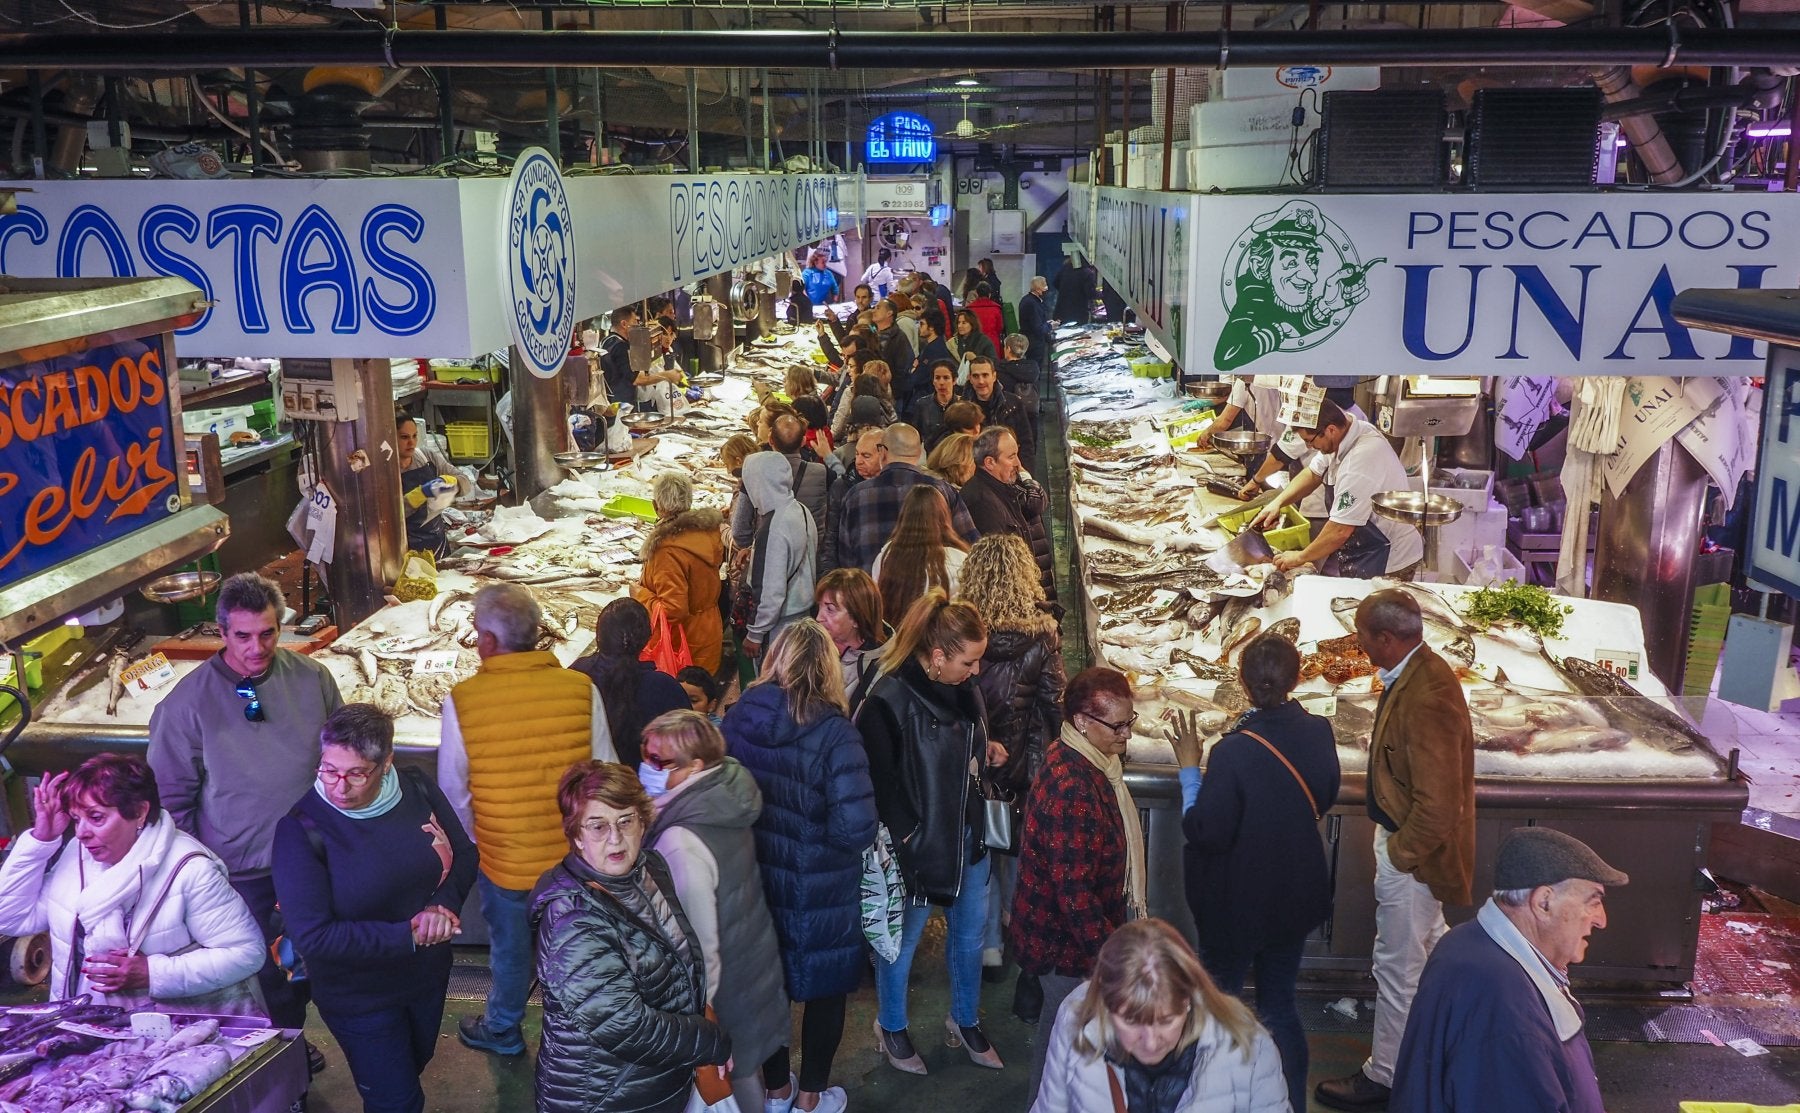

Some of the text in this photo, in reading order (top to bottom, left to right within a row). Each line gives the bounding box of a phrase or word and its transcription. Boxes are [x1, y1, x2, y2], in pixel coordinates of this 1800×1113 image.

[512, 164, 570, 249] CASA FUNDADA POR
[670, 178, 840, 282] PESCADOS COSTAS
[1407, 210, 1771, 251] PESCADOS
[1128, 201, 1168, 330] UNAI
[1634, 388, 1674, 424] UNAI
